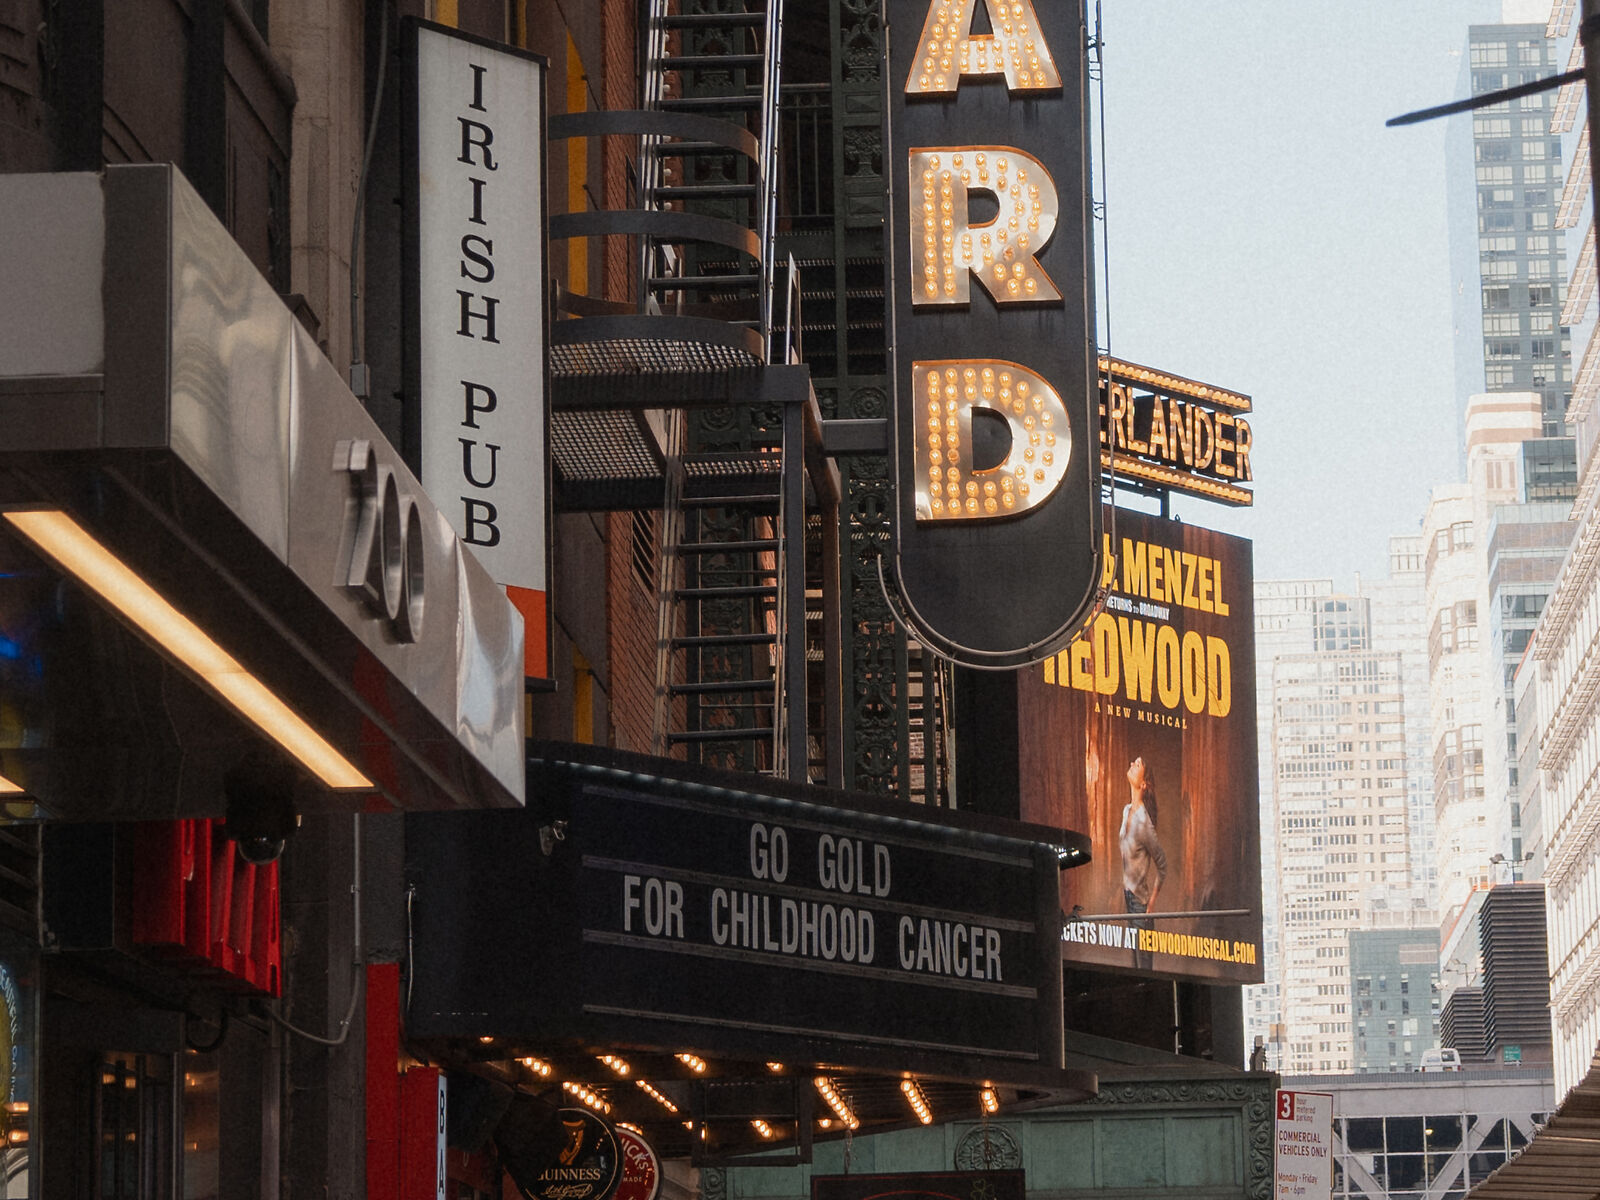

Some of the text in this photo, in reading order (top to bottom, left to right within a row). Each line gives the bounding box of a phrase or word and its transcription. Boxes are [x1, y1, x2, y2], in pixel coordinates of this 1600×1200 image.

[905, 0, 1072, 521] ARD
[455, 63, 501, 548] IRISH PUB
[1122, 537, 1230, 617] MENZEL
[1094, 702, 1188, 730] A NEW MUSICAL
[750, 823, 892, 898] GO GOLD
[624, 875, 1002, 982] FOR CHILDHOOD CANCER
[1061, 921, 1256, 965] CKETS NOW AT REDWOODMUSICAL.COM
[1281, 1093, 1291, 1118] 3
[1278, 1130, 1321, 1143] COMMERCIAL
[1278, 1144, 1328, 1158] VEHICLES ONLY
[537, 1167, 601, 1181] UINNESS
[1278, 1172, 1298, 1183] Monday
[1302, 1173, 1318, 1185] Friday
